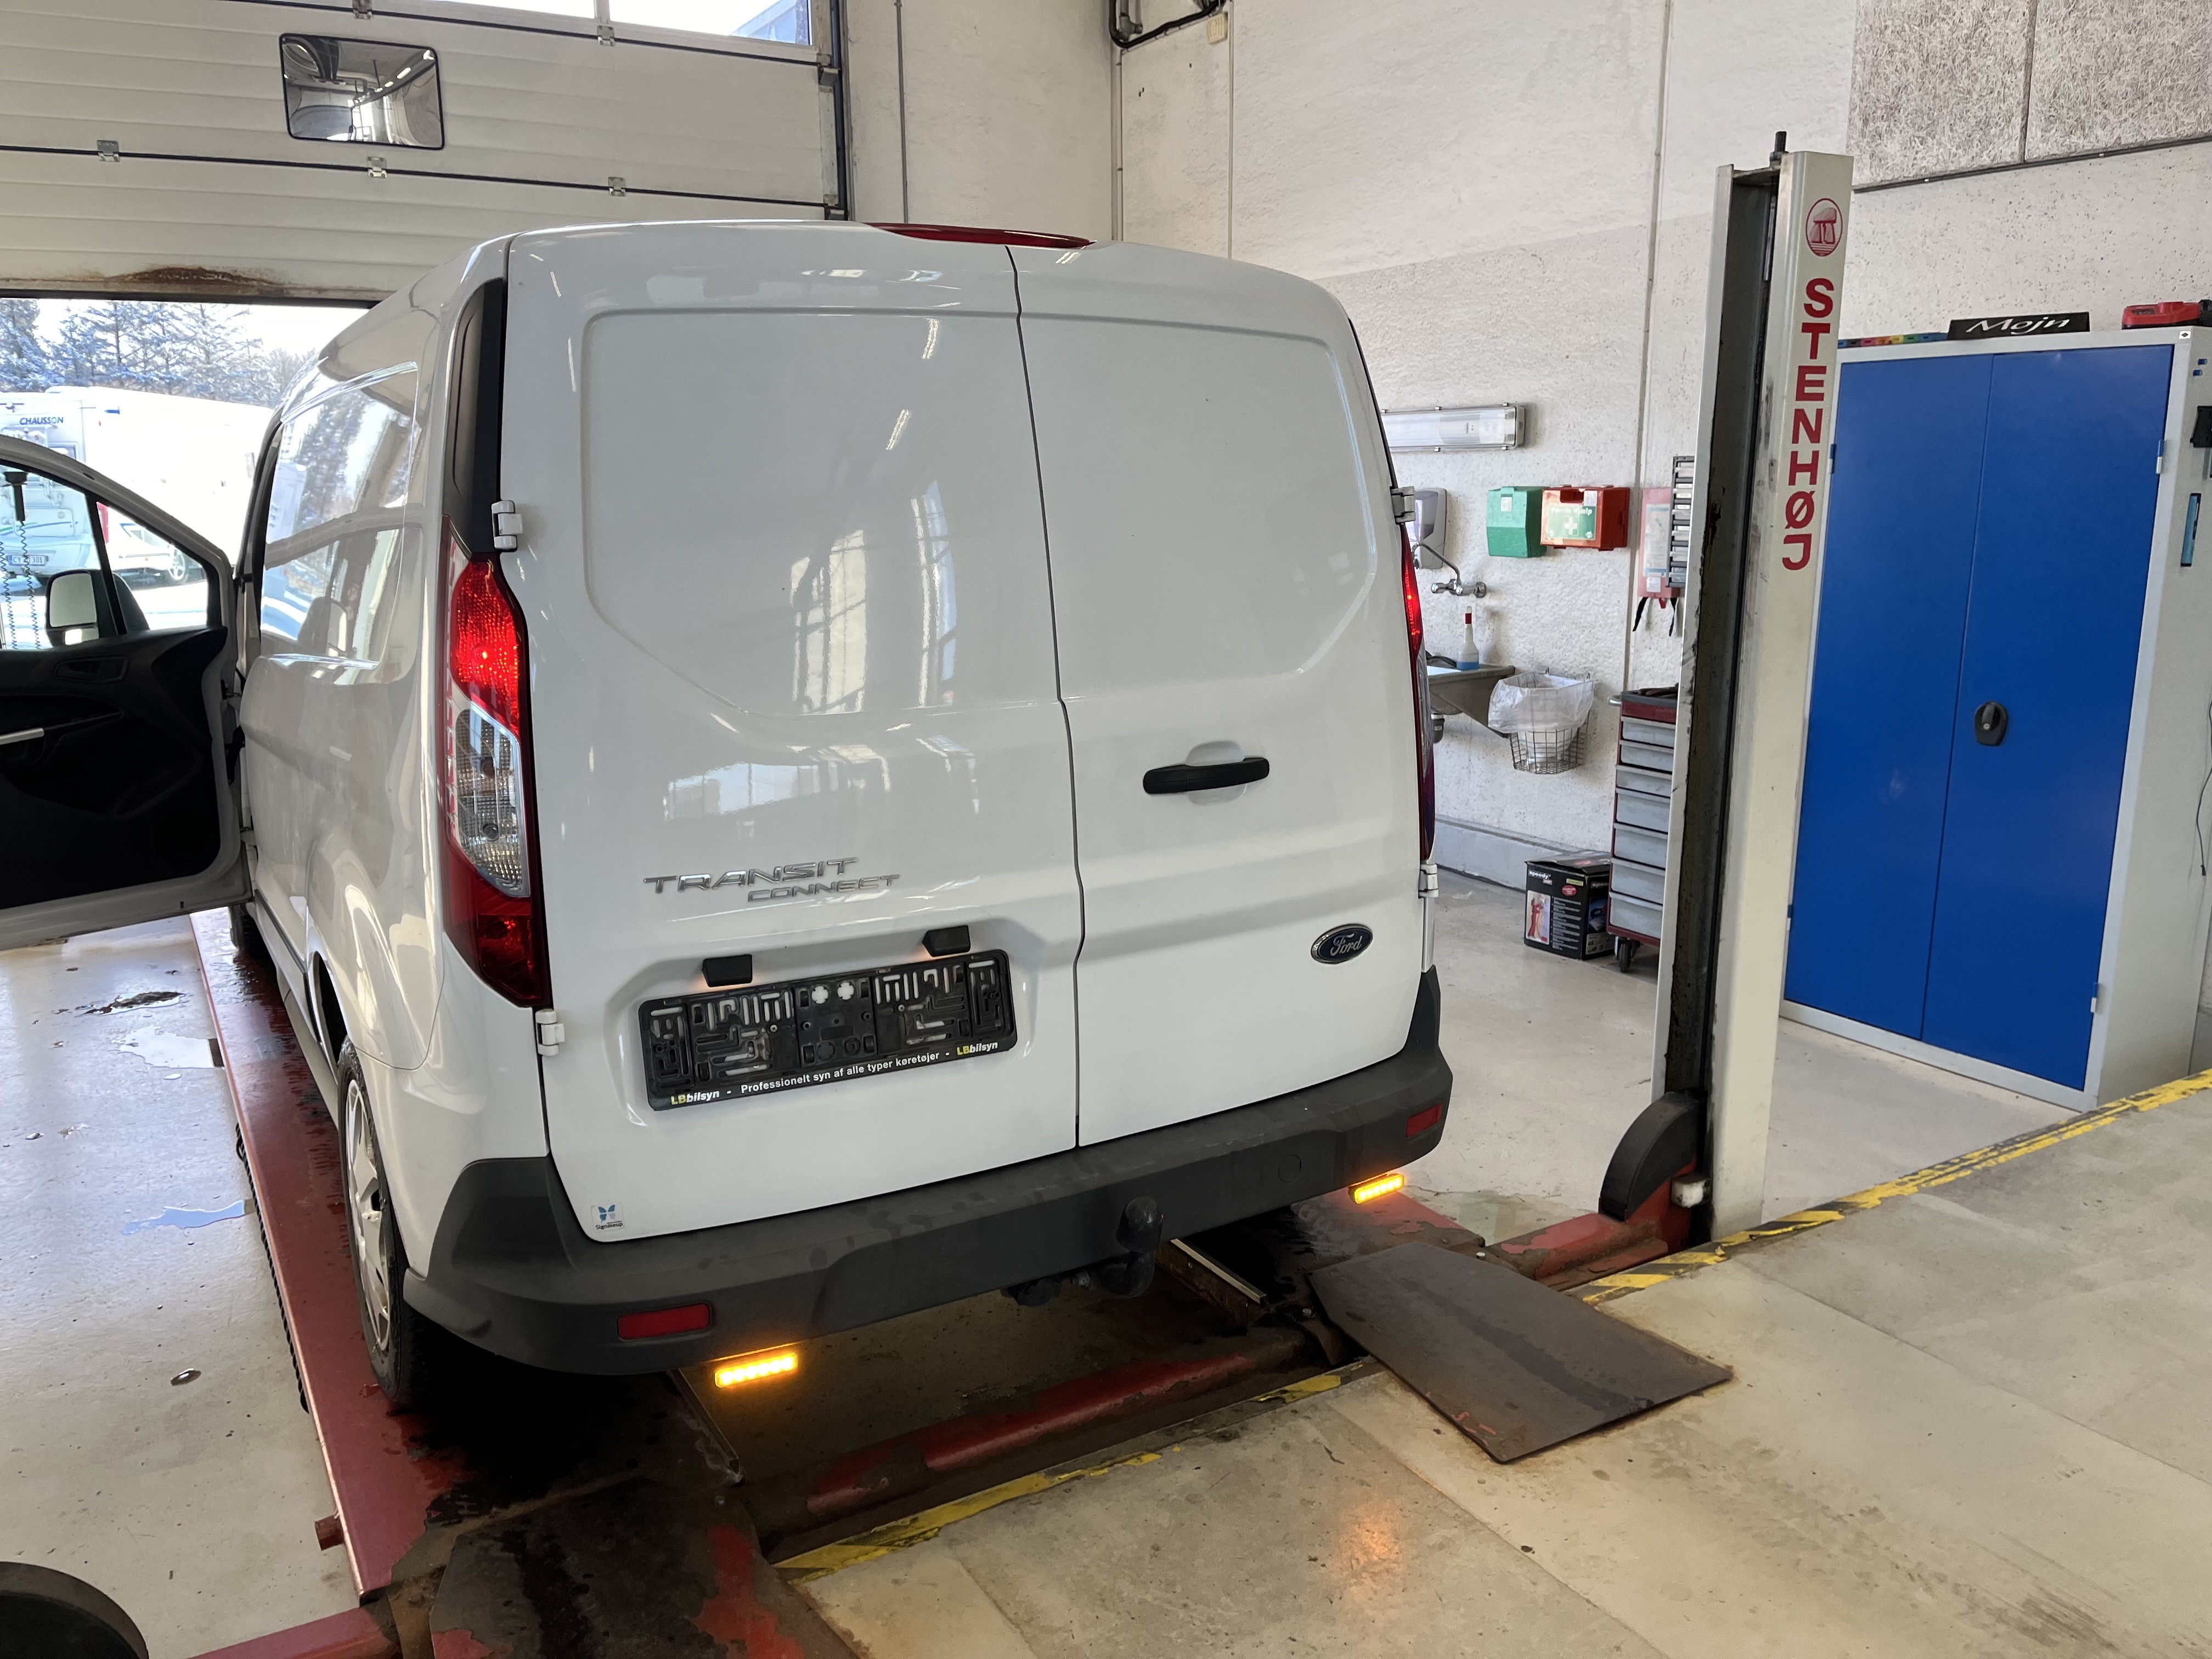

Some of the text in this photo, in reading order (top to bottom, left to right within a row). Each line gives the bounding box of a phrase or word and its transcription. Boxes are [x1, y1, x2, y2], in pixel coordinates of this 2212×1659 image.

[1966, 317, 2070, 335] Mojn
[19, 416, 64, 425] CHAUSSON
[1782, 278, 1834, 571] STENHØJ
[644, 857, 857, 894] TRANSIT
[1529, 871, 1549, 879] speedy
[748, 874, 900, 902] CONNECT
[1330, 933, 1363, 956] Ford
[671, 1090, 720, 1105] LBbilsyn
[741, 1074, 810, 1093] Professionelt
[813, 1071, 831, 1082] syn
[833, 1068, 844, 1077] af
[847, 1064, 865, 1075] alle
[867, 1060, 893, 1074] typer
[895, 1051, 940, 1066] køretøjer
[957, 1040, 998, 1056] LBbilsyn
